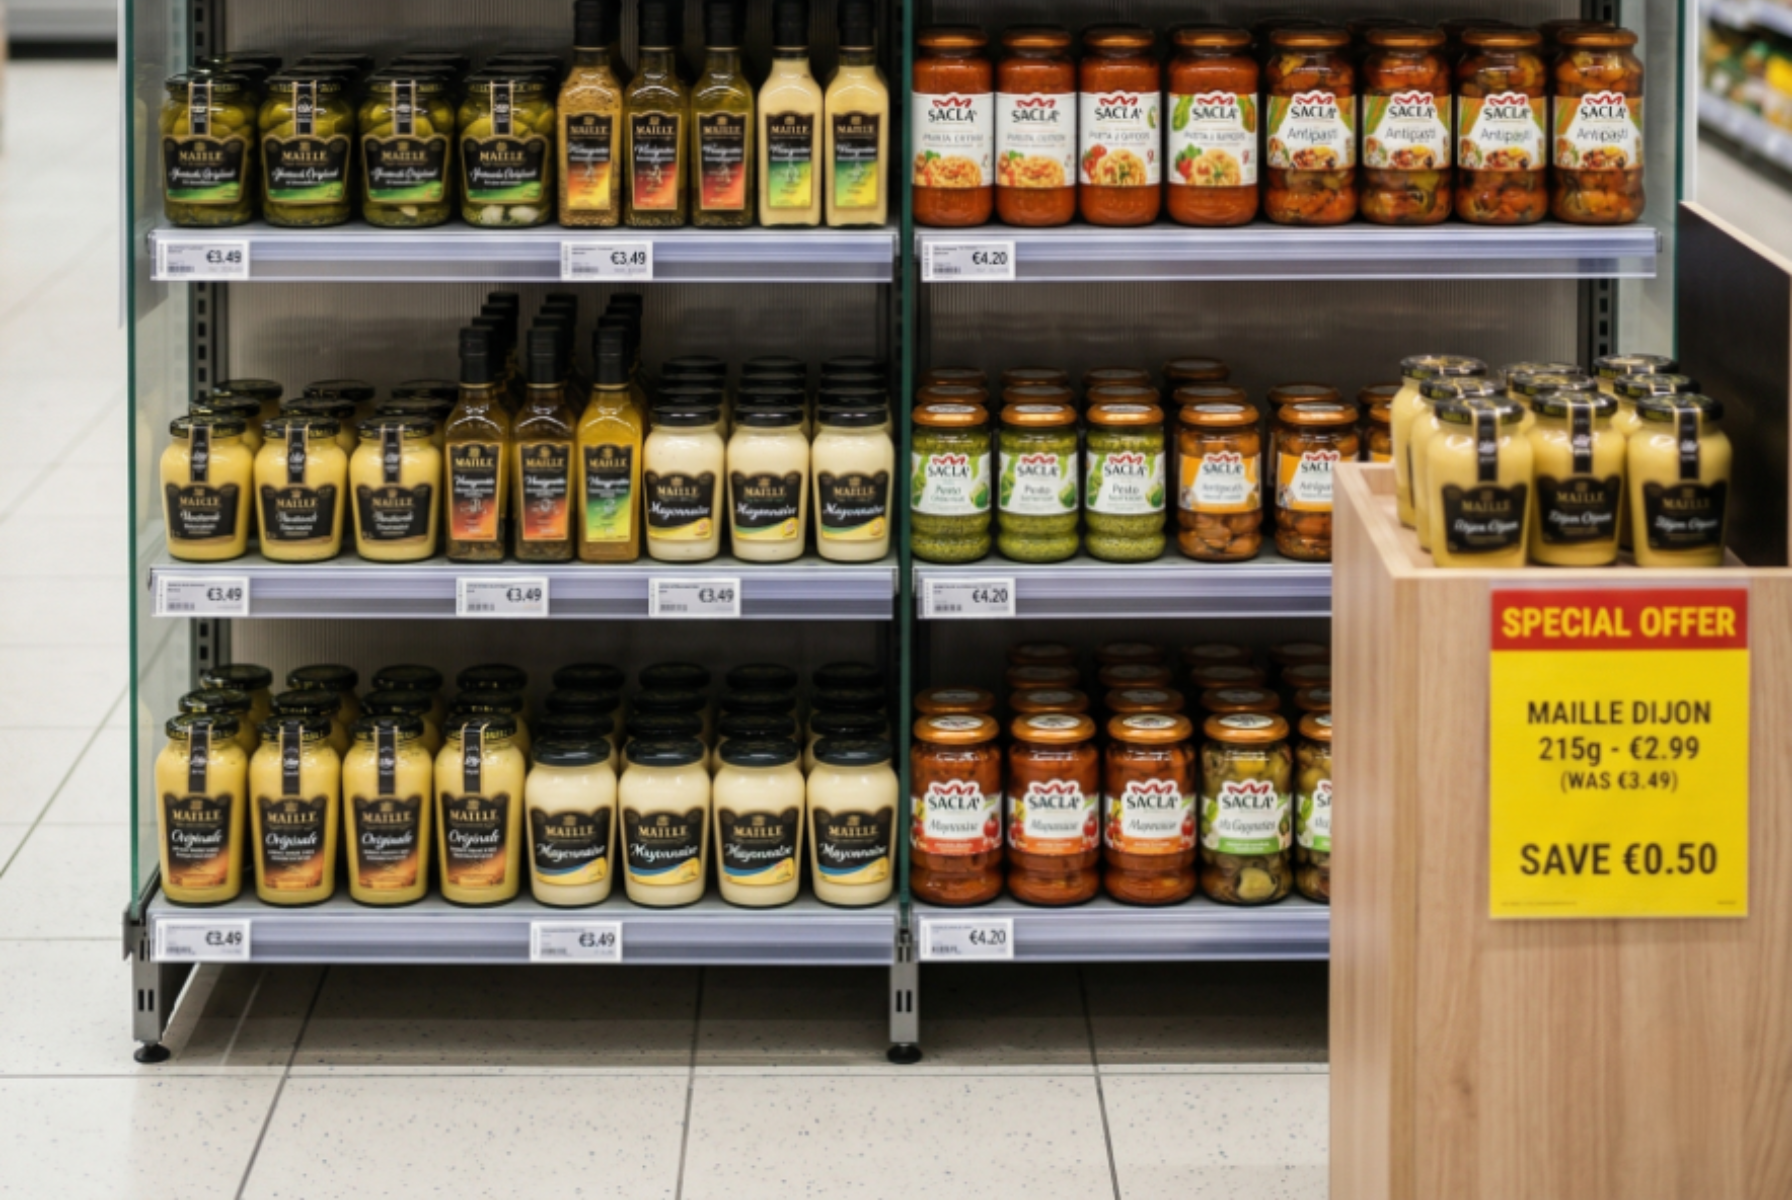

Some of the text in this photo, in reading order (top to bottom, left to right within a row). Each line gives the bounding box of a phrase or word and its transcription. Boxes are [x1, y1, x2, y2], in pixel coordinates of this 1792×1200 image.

[1287, 127, 1337, 143] Antipasti
[1386, 127, 1436, 143] Antipasti
[1481, 128, 1532, 143] Antipasti
[1577, 128, 1628, 143] Antipasti
[179, 151, 222, 161] MAILLE
[282, 151, 326, 161] MAILLE
[381, 152, 426, 161] MAILLE
[479, 151, 523, 161] MAILLE
[611, 252, 646, 264] €3.49
[973, 252, 1007, 264] €4.20
[456, 458, 493, 467] MAILLE
[526, 458, 563, 468] MAILLE
[590, 458, 627, 468] MAILLE
[1301, 461, 1332, 471] SACL
[657, 486, 699, 496] MAILLE
[744, 486, 785, 497] MAILLE
[834, 487, 874, 496] MAILLE
[1113, 483, 1139, 495] Pesto
[1557, 491, 1603, 504] MAILLE
[207, 588, 242, 601] €3.49
[506, 589, 541, 601] €3.49
[699, 589, 734, 602] €3.49
[972, 589, 1008, 603] €4.20
[1502, 607, 1736, 638] SPECIAL OFFER
[1527, 701, 1711, 725] MAILLE DIJON
[1539, 737, 1602, 767] 215g
[1629, 736, 1699, 761] €2.99
[1560, 771, 1678, 793] (WAS €3.49)
[173, 809, 220, 821] MAILLE
[267, 811, 316, 823] MAILLE
[362, 812, 411, 823] MAILLE
[450, 809, 497, 821] MAILLE
[545, 825, 594, 838] MAILLE
[638, 825, 688, 838] MAILLE
[734, 825, 782, 838] MAILLE
[828, 825, 878, 837] MAILLE
[1520, 842, 1717, 875] SAVE €0.50
[206, 931, 242, 945] €3.49
[579, 933, 614, 947] €3.49
[969, 930, 1005, 945] €4.20
